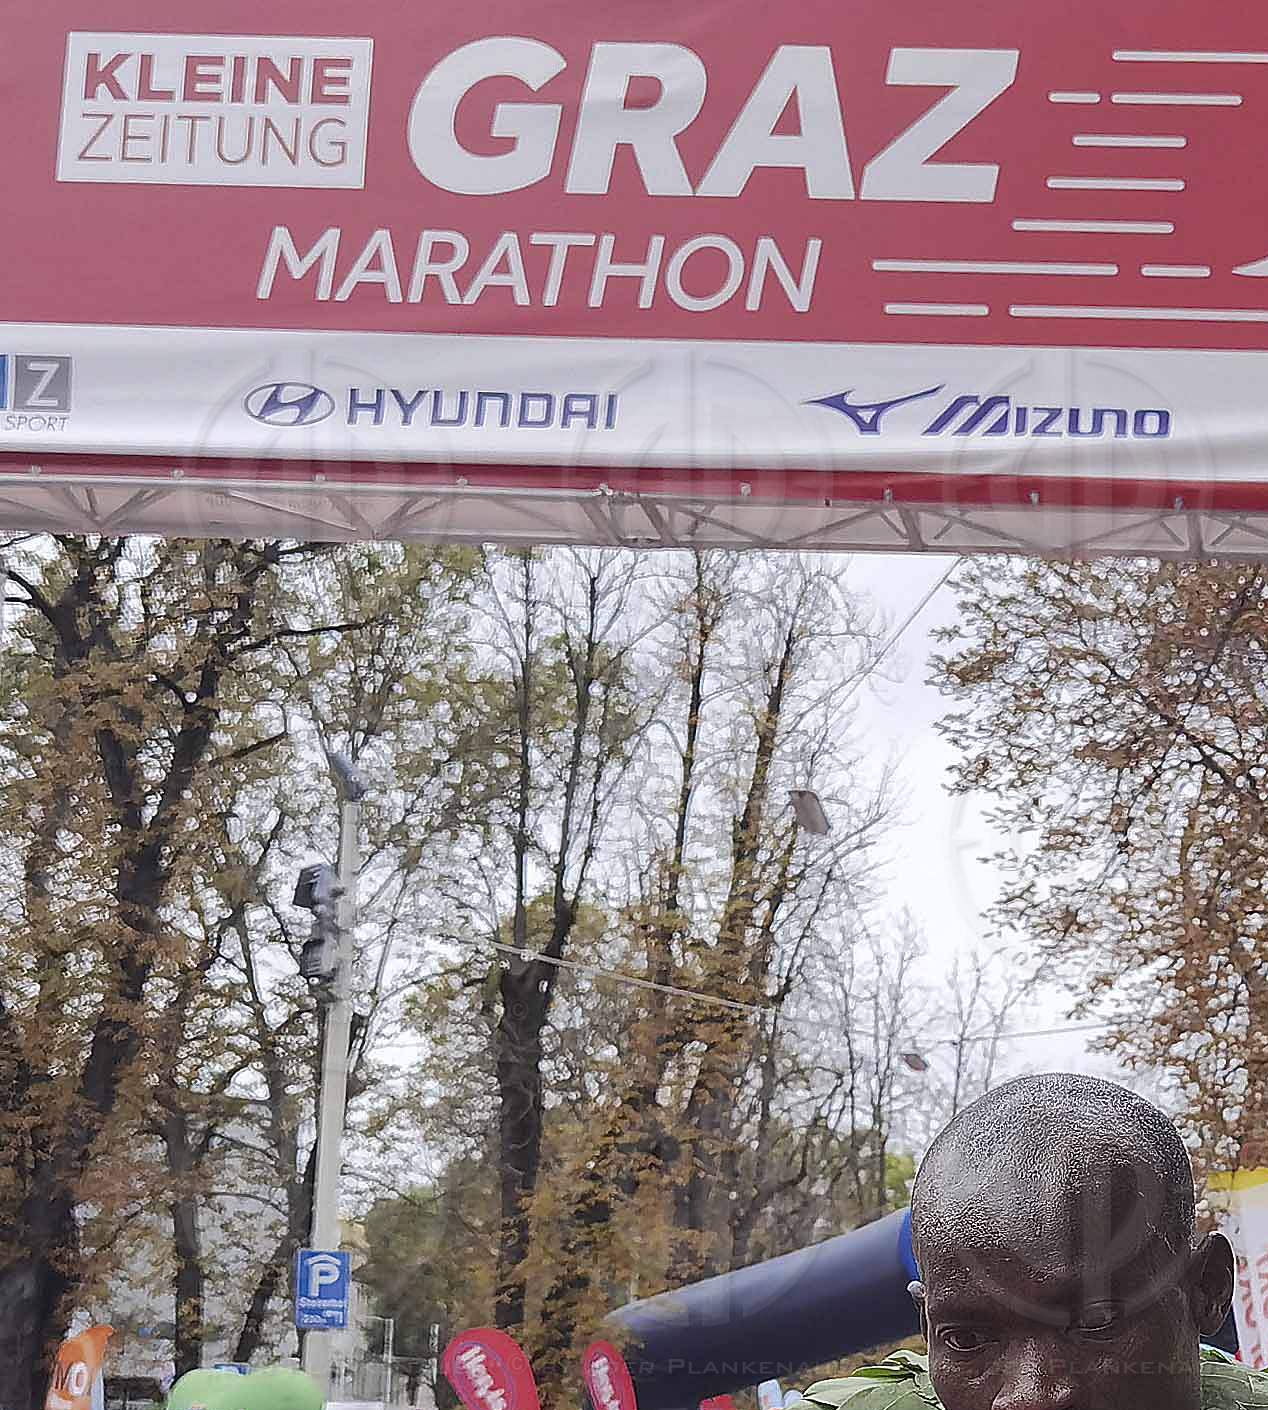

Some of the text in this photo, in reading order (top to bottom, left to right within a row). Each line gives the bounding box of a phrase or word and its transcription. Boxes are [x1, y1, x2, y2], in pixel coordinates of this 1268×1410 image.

[84, 52, 354, 106] KLEINE
[78, 111, 349, 168] ZEITUNG
[406, 35, 1020, 203] GRAZ
[256, 226, 823, 313] MARATHON
[4, 414, 69, 433] SPORT
[346, 387, 619, 431] HYUNDAI
